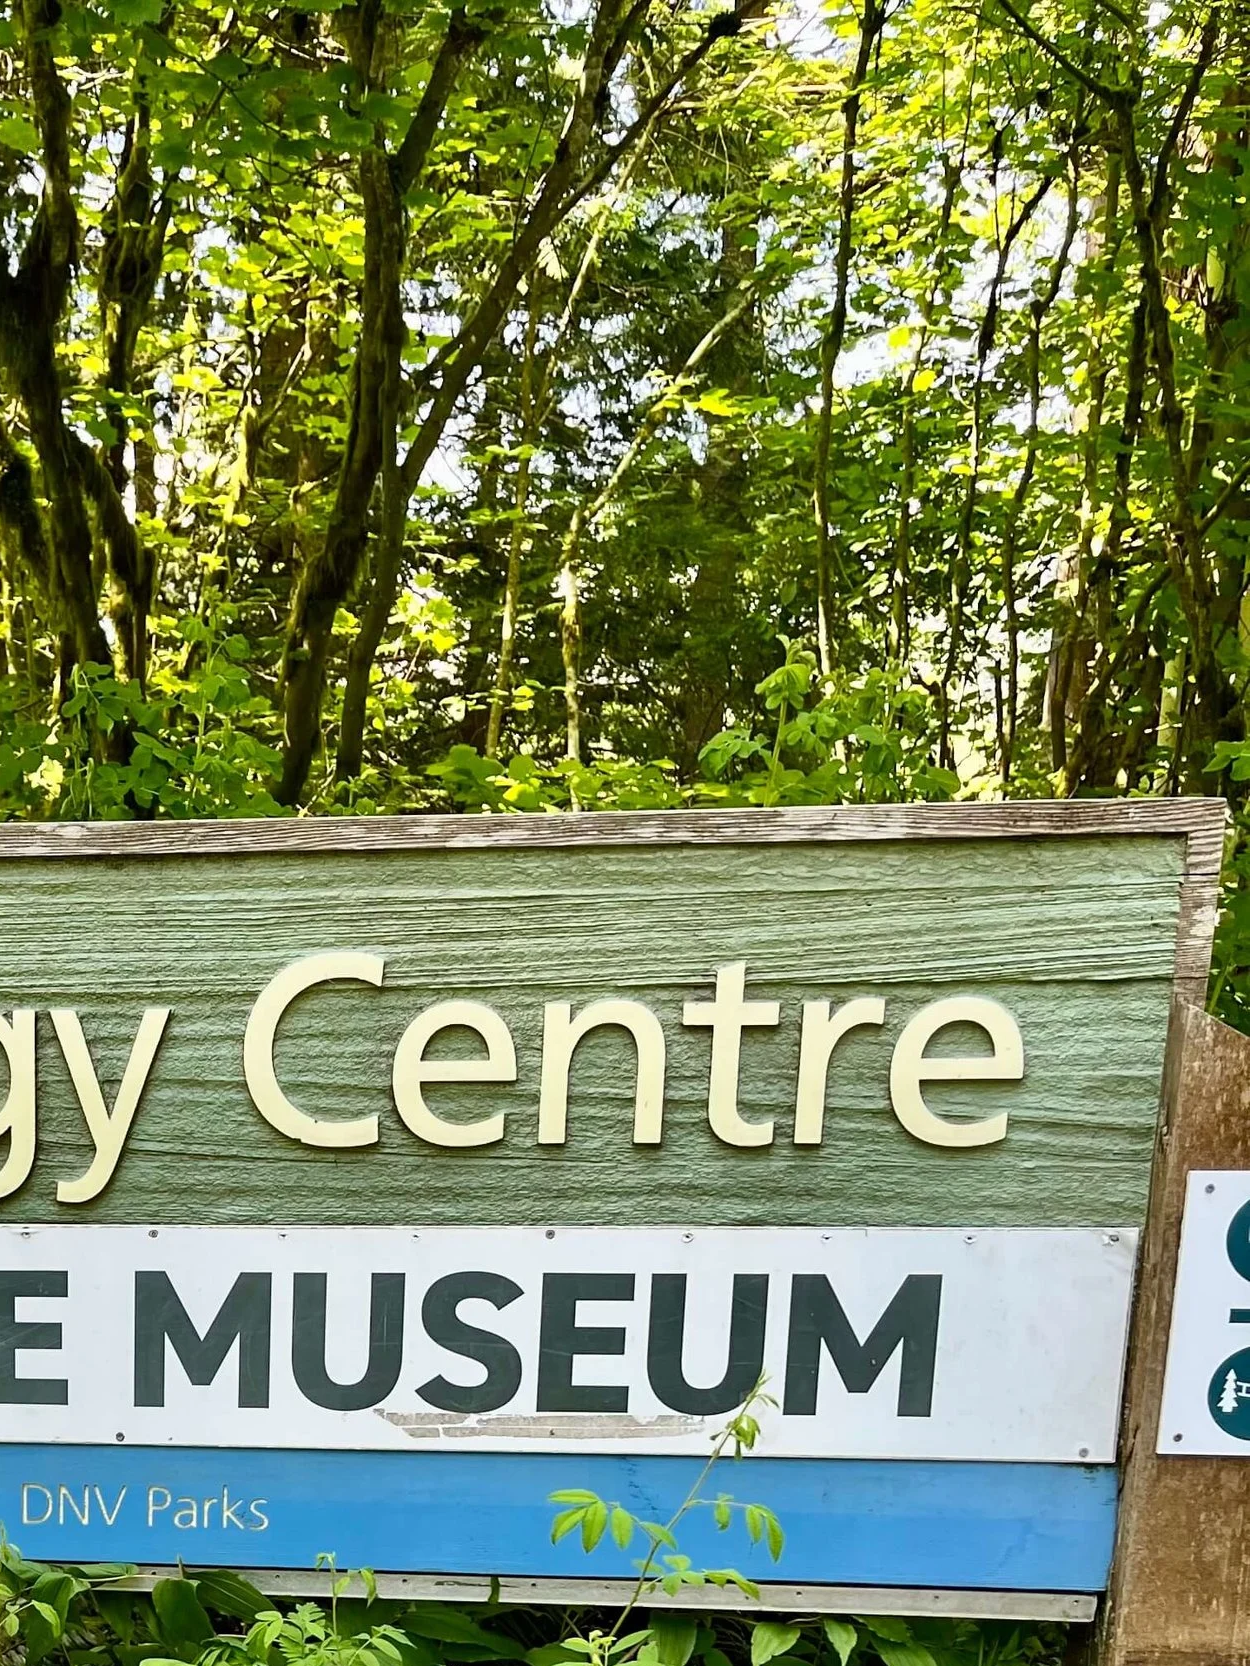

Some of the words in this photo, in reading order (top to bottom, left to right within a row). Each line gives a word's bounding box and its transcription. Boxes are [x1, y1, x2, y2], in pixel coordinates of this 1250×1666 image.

[243, 951, 1025, 1148] Centre
[134, 1270, 942, 1417] MUSEUM
[21, 1482, 126, 1526] DNV
[146, 1484, 270, 1531] Parks
